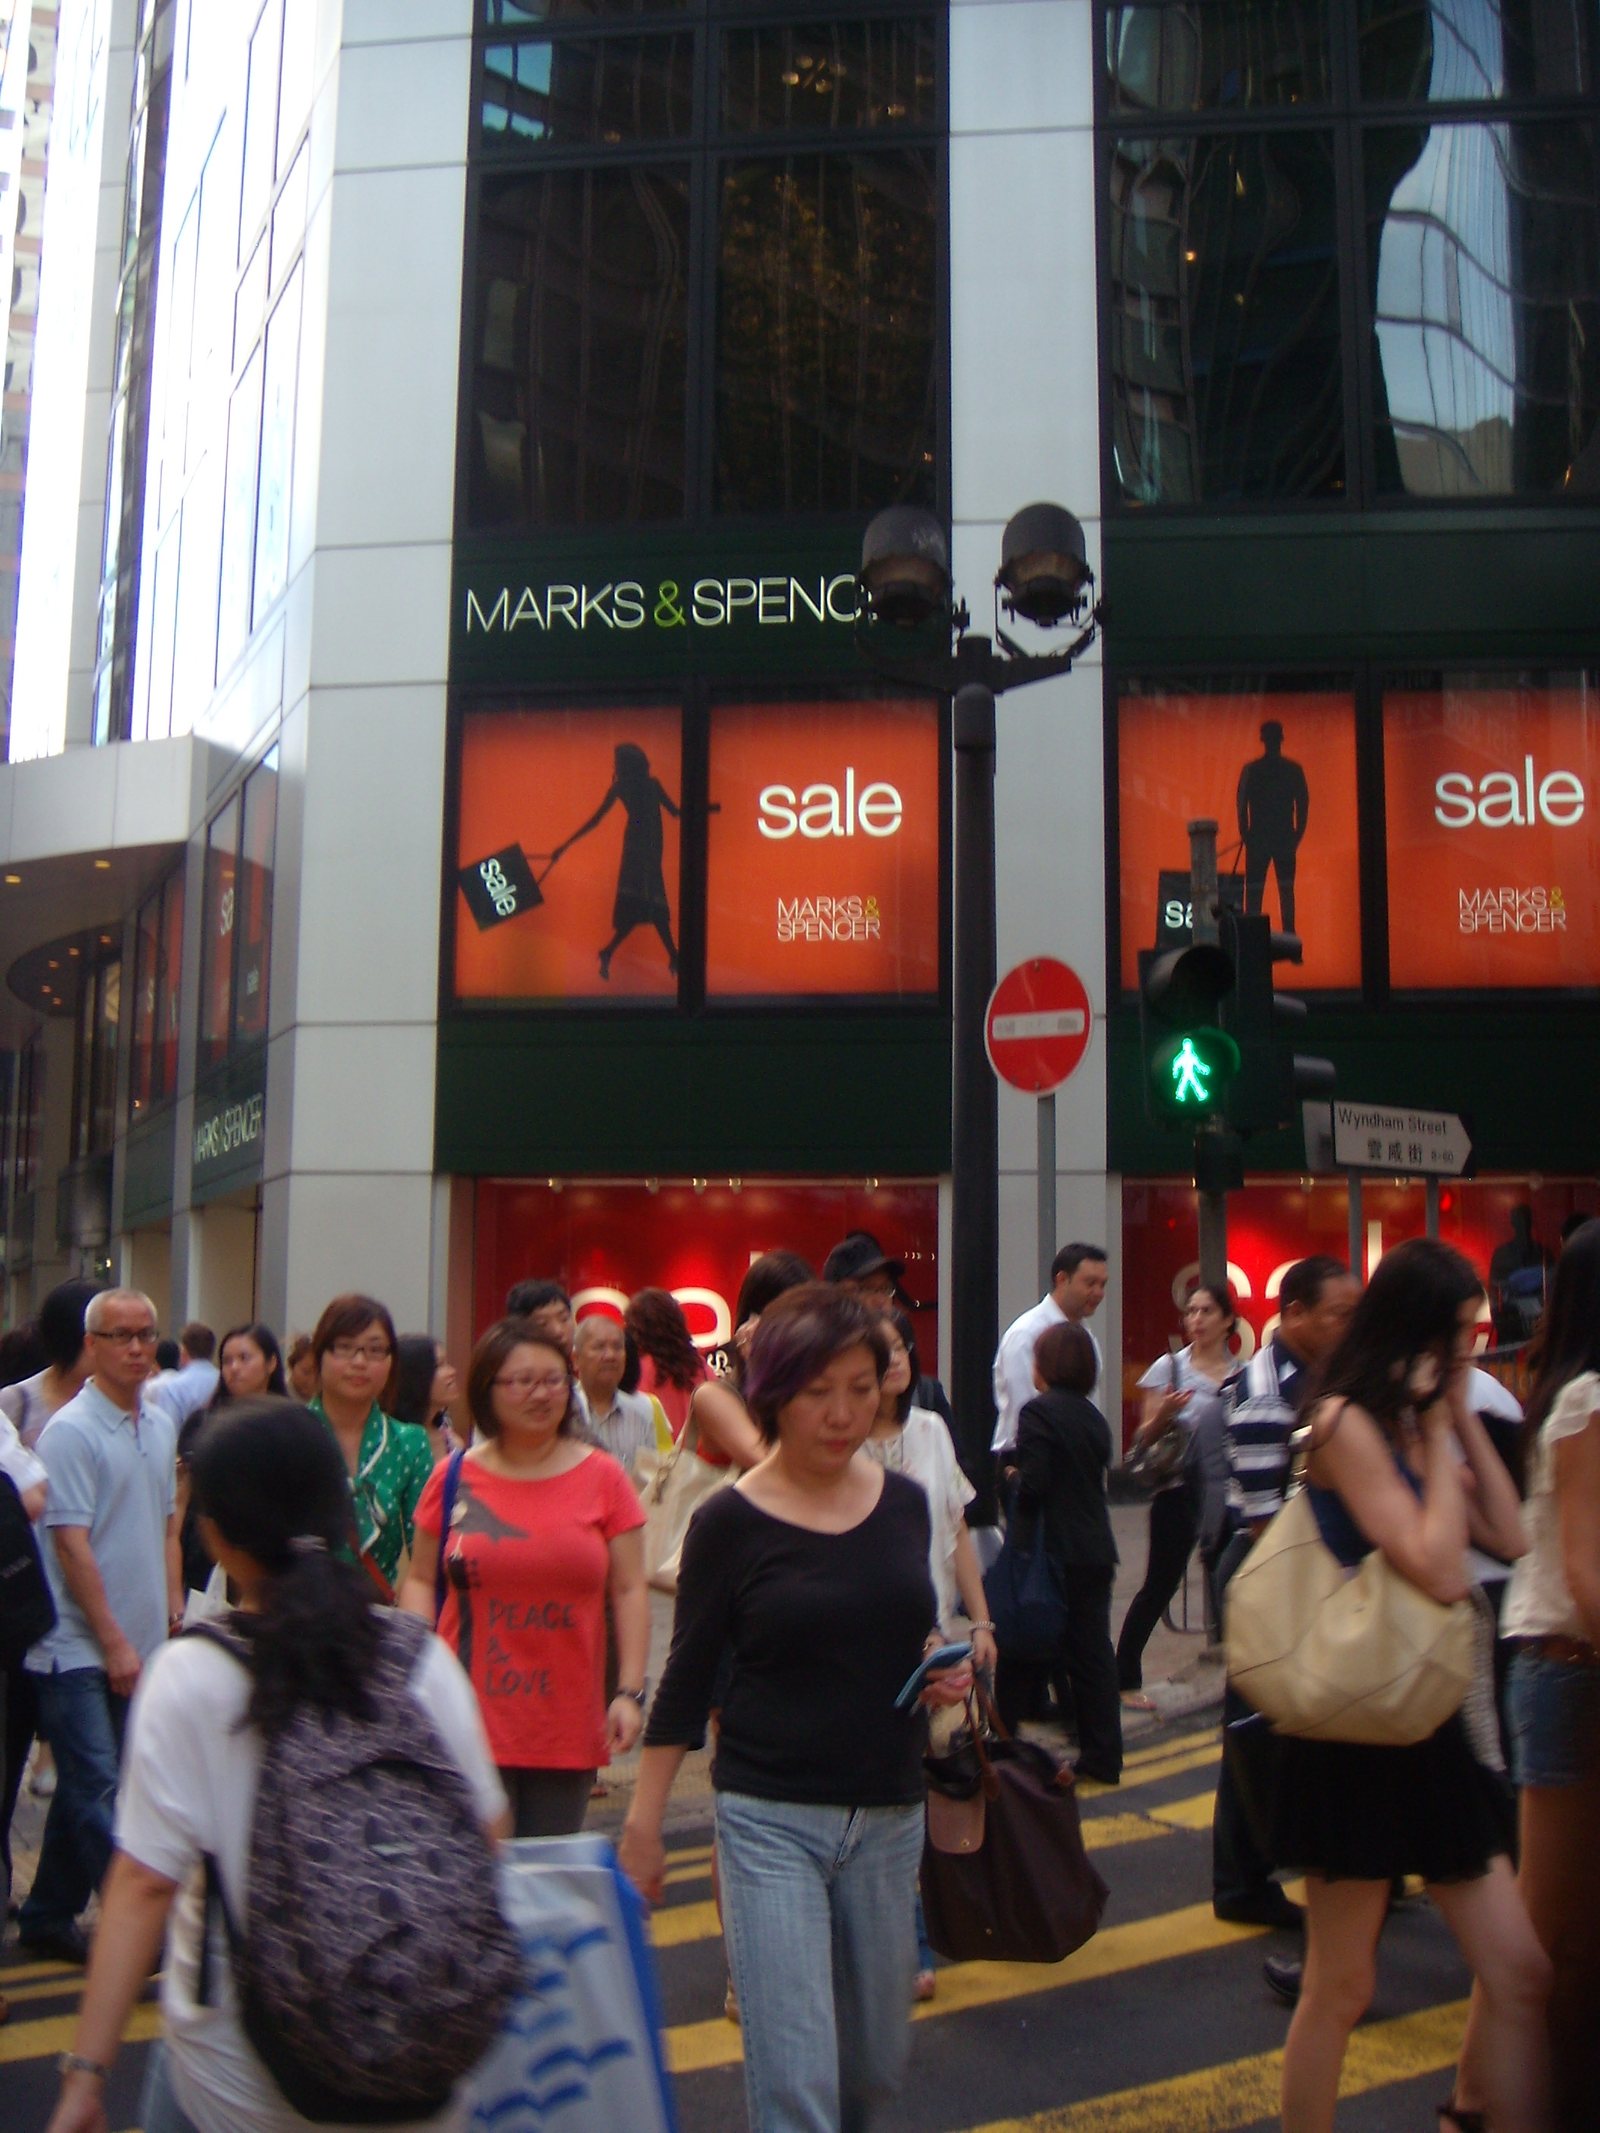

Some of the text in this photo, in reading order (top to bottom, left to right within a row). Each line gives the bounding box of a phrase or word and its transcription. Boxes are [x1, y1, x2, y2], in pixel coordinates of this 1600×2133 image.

[466, 574, 877, 633] MARKS & SPENC
[757, 767, 902, 839] sale
[1434, 754, 1585, 828] sale
[480, 858, 517, 916] sale
[1459, 886, 1565, 911] MARKS &
[777, 896, 880, 920] MARKS &
[1459, 907, 1567, 933] SPENCER
[777, 917, 880, 941] SPENCER
[1338, 1106, 1447, 1136] Wyndham Street
[488, 1598, 576, 1630] PEACE
[484, 1668, 552, 1697] LOVE
